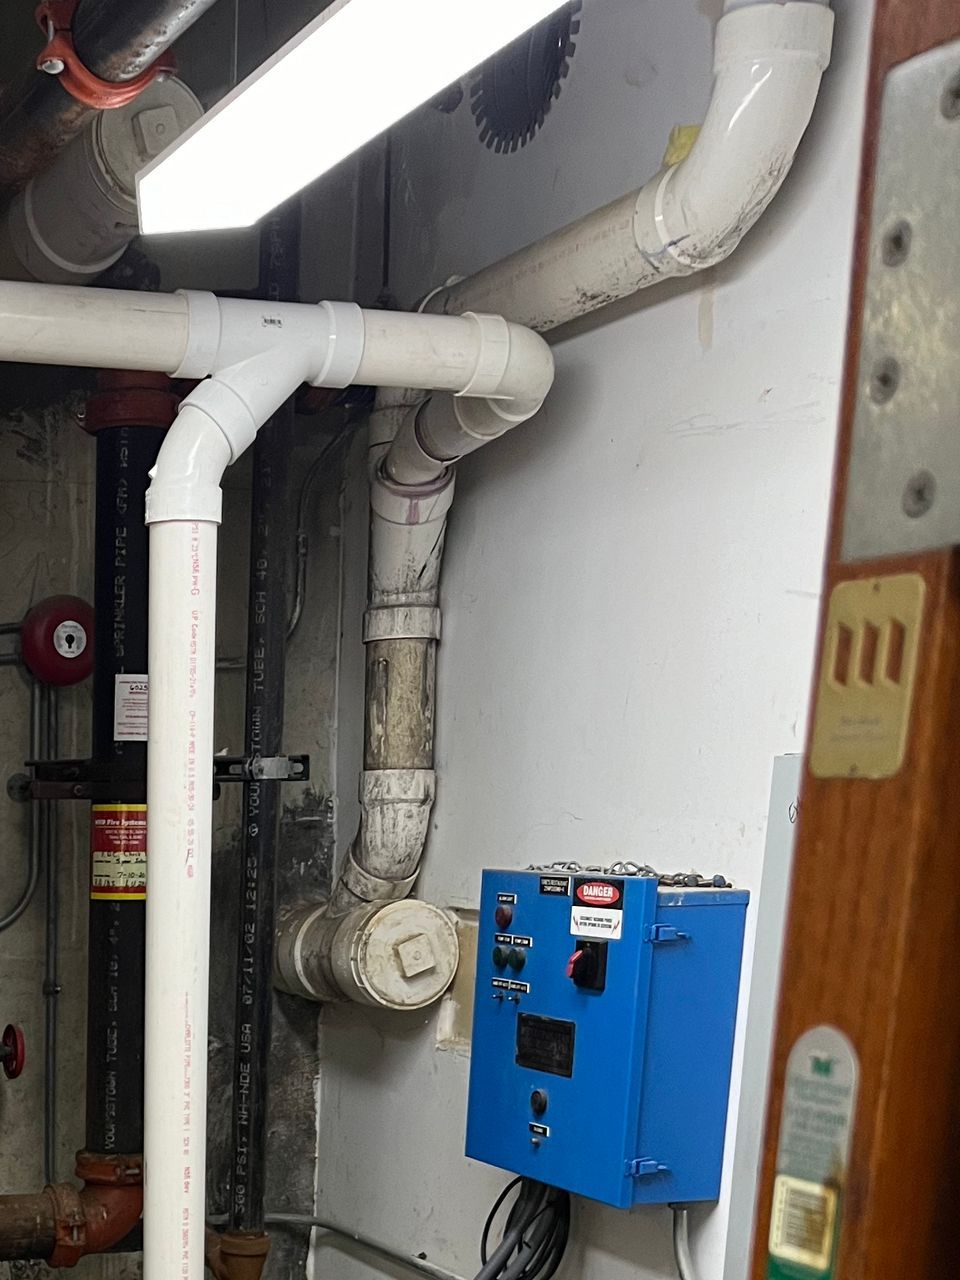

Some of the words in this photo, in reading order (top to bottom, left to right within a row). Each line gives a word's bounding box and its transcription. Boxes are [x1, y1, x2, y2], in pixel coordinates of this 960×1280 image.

[114, 527, 127, 567] PIPE
[254, 591, 266, 624] SCH
[245, 856, 258, 911] 12:25
[583, 885, 613, 897] DANGER
[242, 922, 255, 1005] 07/11/02
[240, 1023, 252, 1053] USA
[237, 1062, 251, 1125] NH-NDE
[234, 1184, 246, 1214] 300
